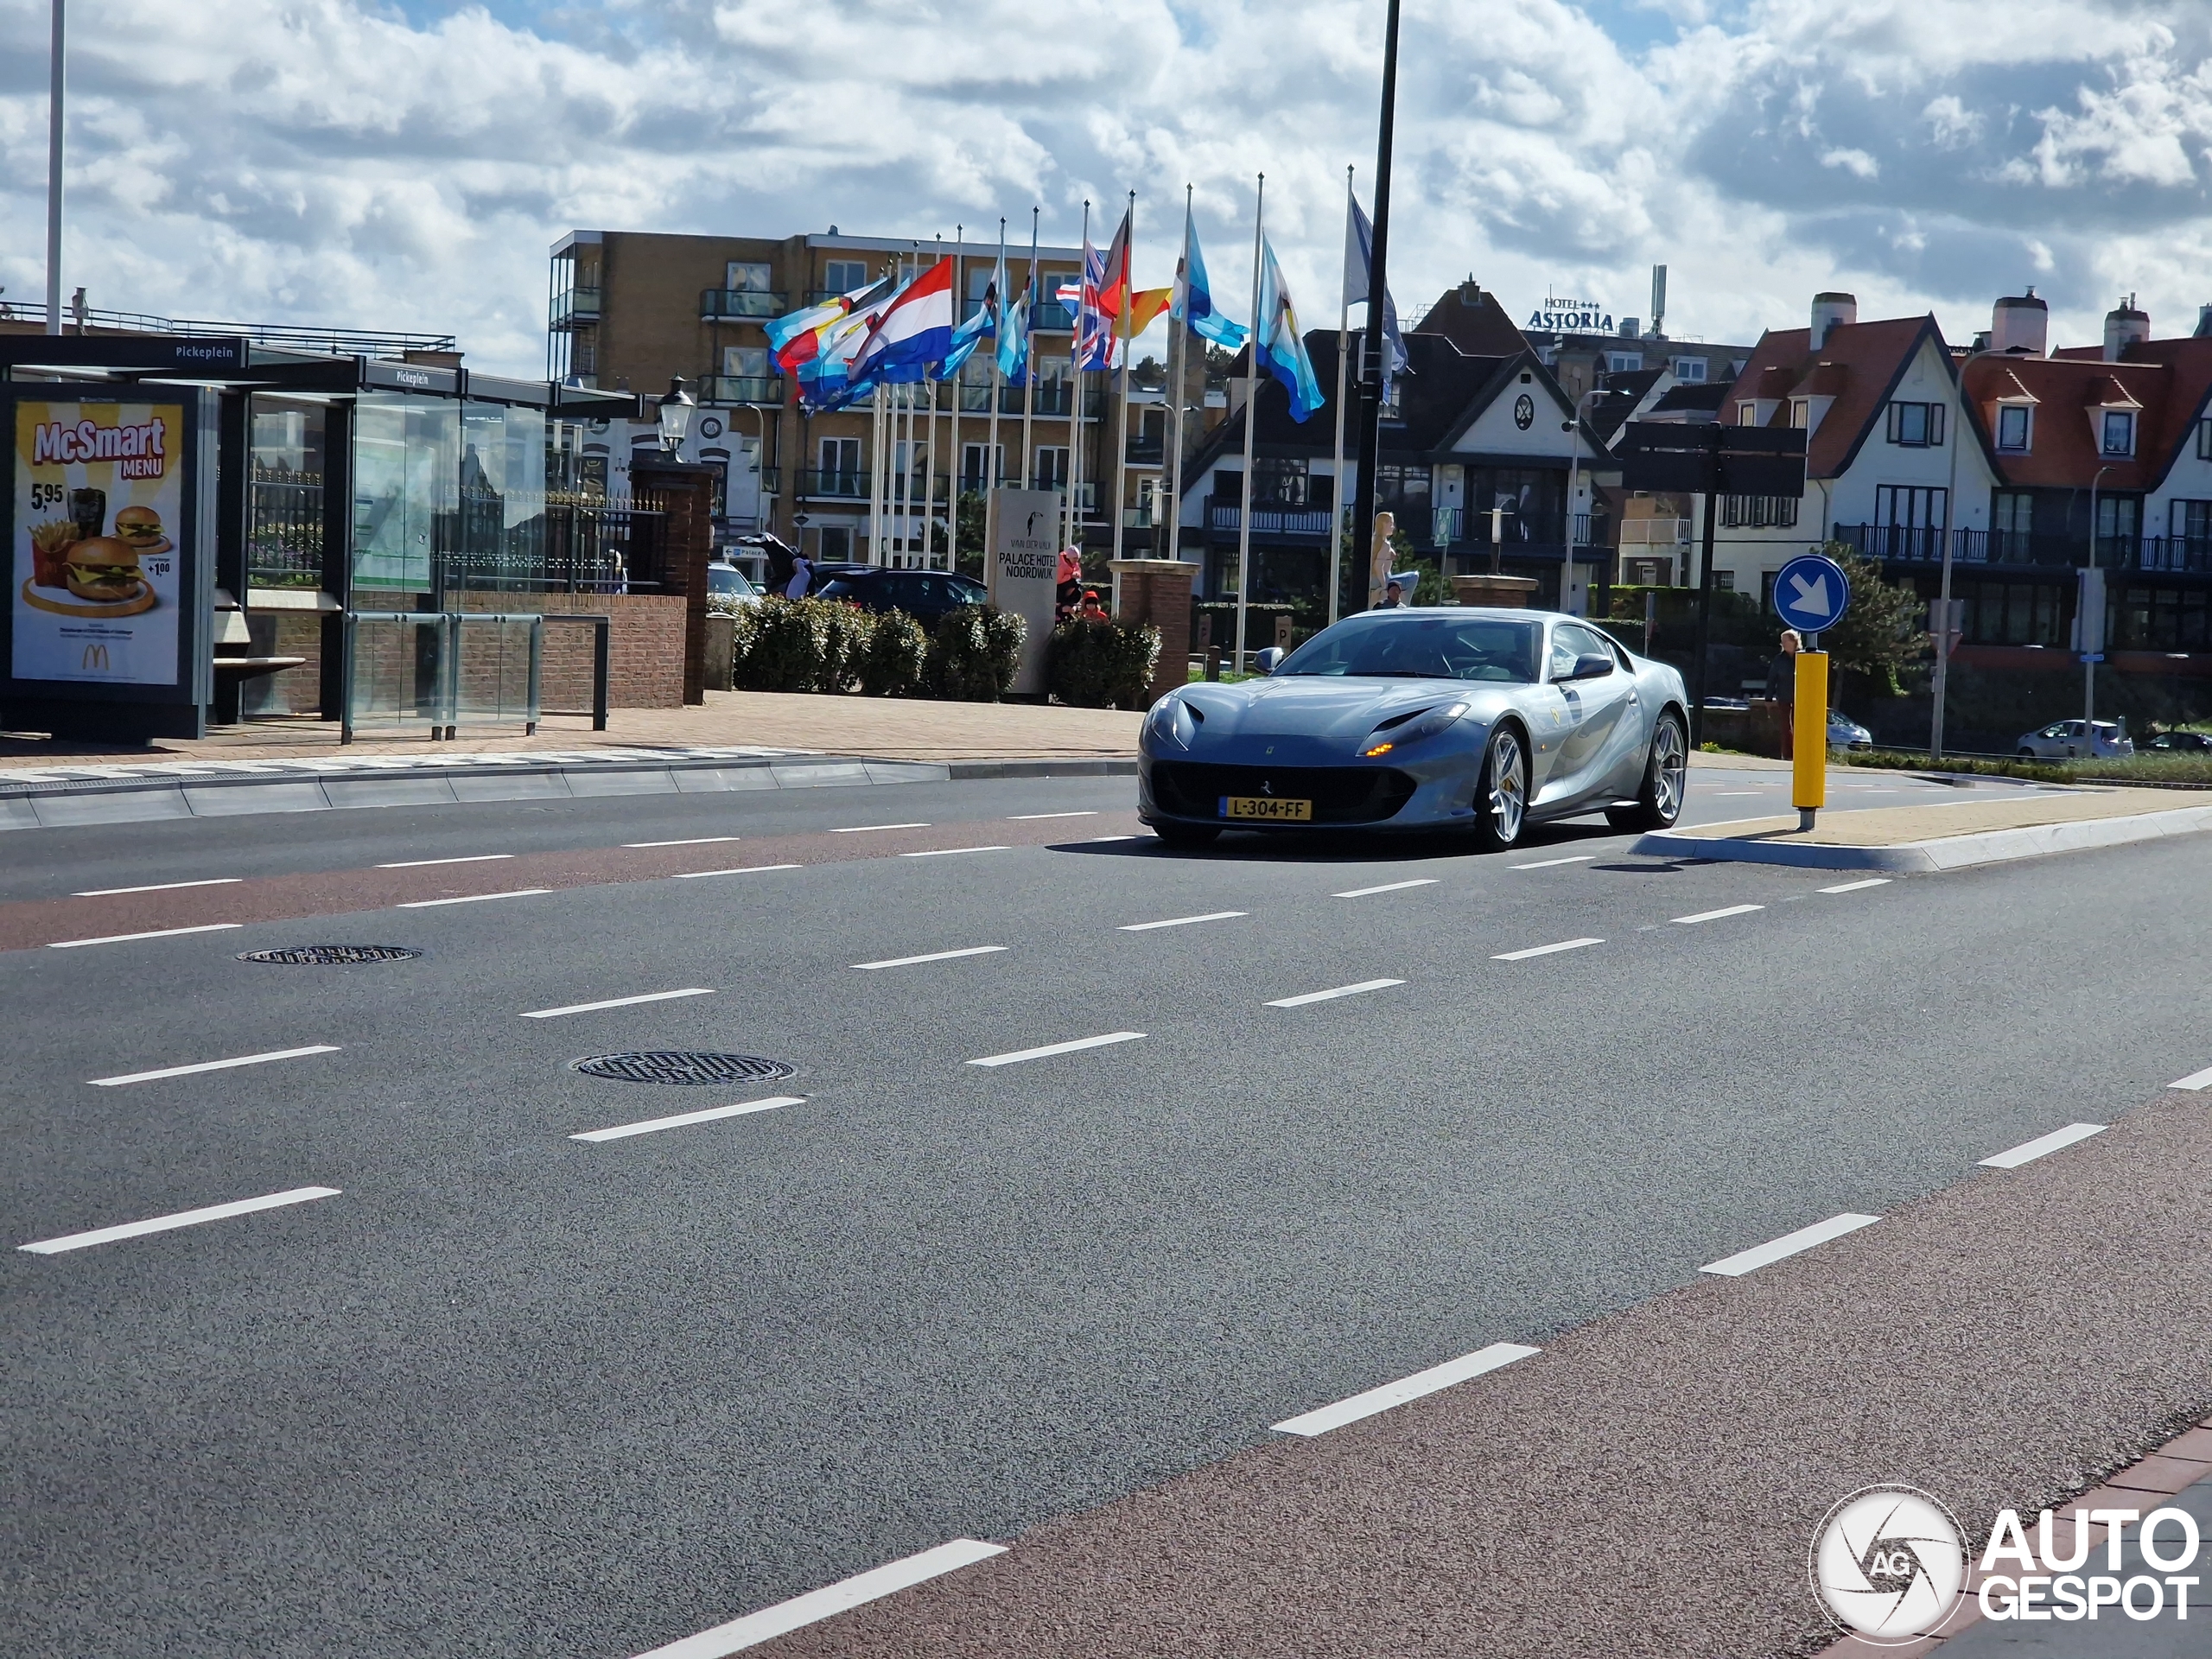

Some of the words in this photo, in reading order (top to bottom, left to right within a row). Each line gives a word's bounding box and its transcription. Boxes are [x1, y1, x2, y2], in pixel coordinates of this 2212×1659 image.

[1544, 298, 1580, 309] HOTEL
[1526, 310, 1614, 332] ASTORIA
[175, 346, 233, 360] Pickeplein
[397, 370, 429, 386] Pickeplein
[34, 417, 164, 463] McSmart
[123, 458, 163, 477] MENU
[30, 483, 63, 513] 5,95
[1010, 539, 1025, 549] VAN
[999, 552, 1035, 566] PALACE
[1036, 554, 1057, 568] HOTEL
[1280, 629, 1287, 644] P
[1233, 799, 1305, 817] L-304-FF
